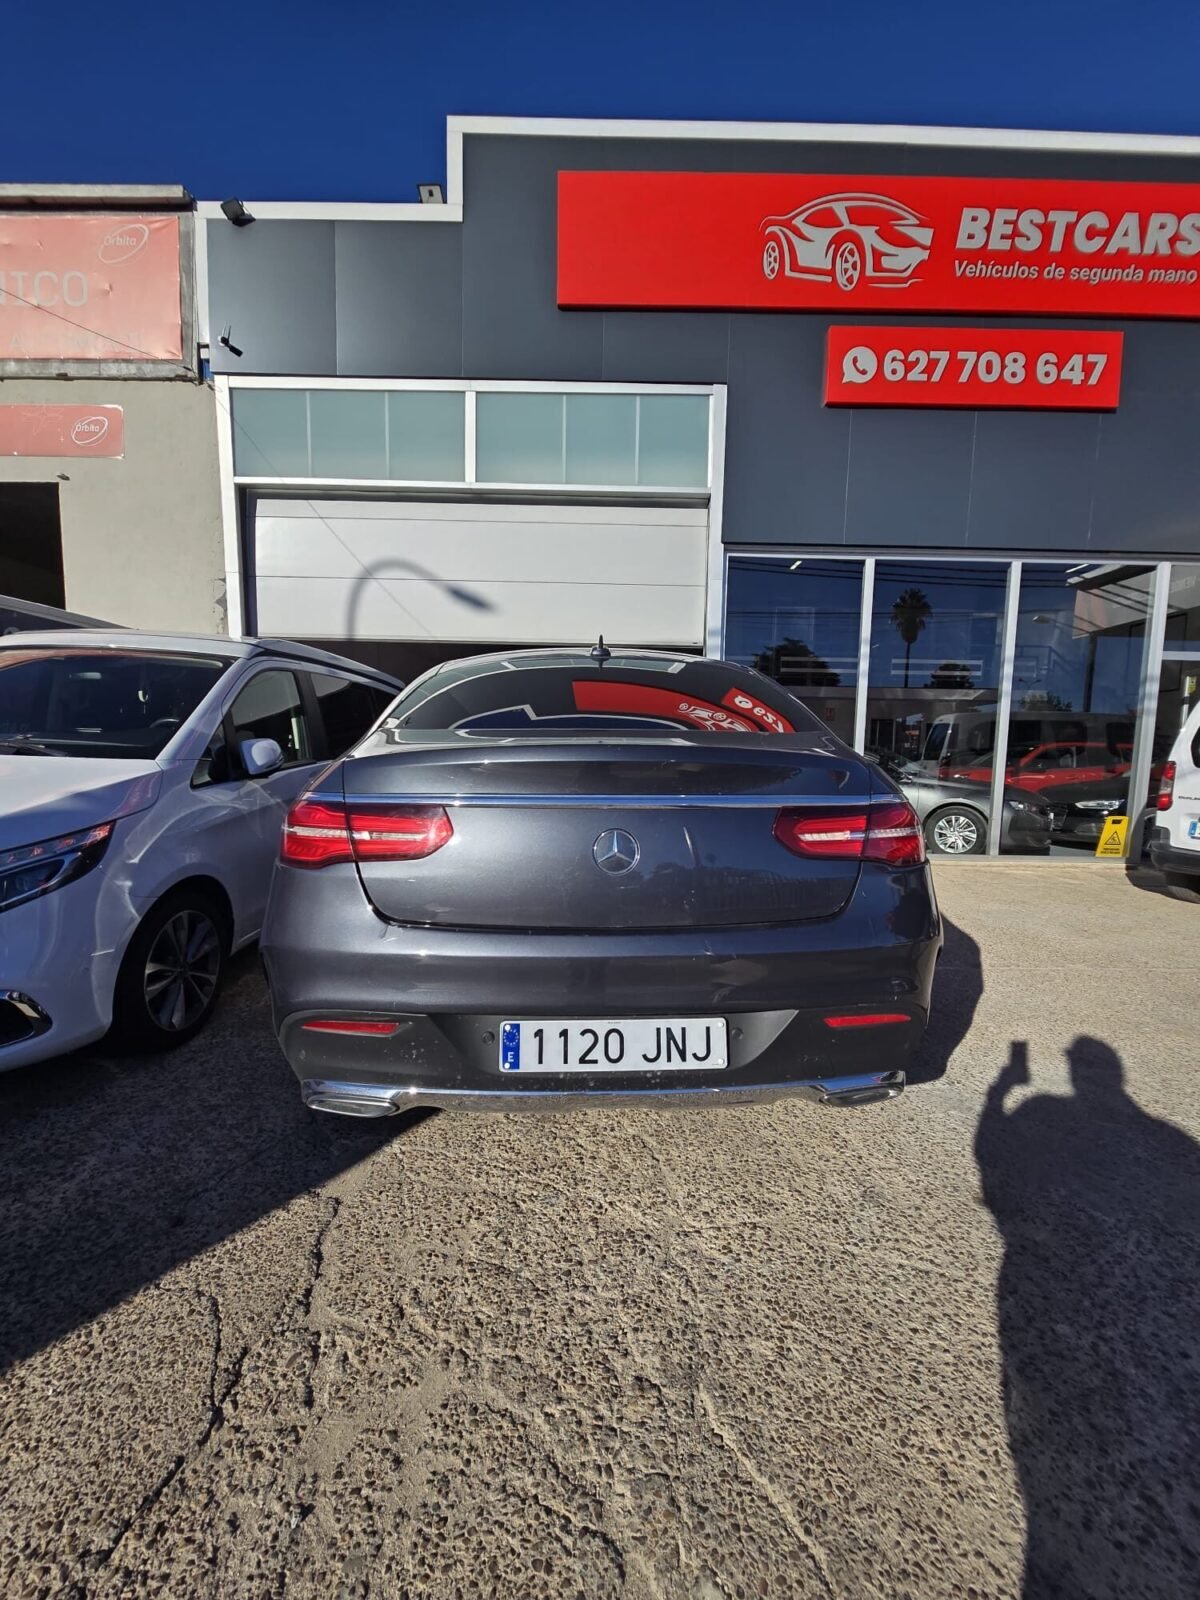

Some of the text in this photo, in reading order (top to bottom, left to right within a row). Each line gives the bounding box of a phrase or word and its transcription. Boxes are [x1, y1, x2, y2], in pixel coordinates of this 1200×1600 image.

[955, 207, 1200, 256] BESTCARS
[955, 260, 1197, 284] Vehículos de segunda mano
[884, 349, 1107, 385] 627 708 647
[507, 1052, 514, 1062] E
[534, 1026, 711, 1064] 1120 JNJ
